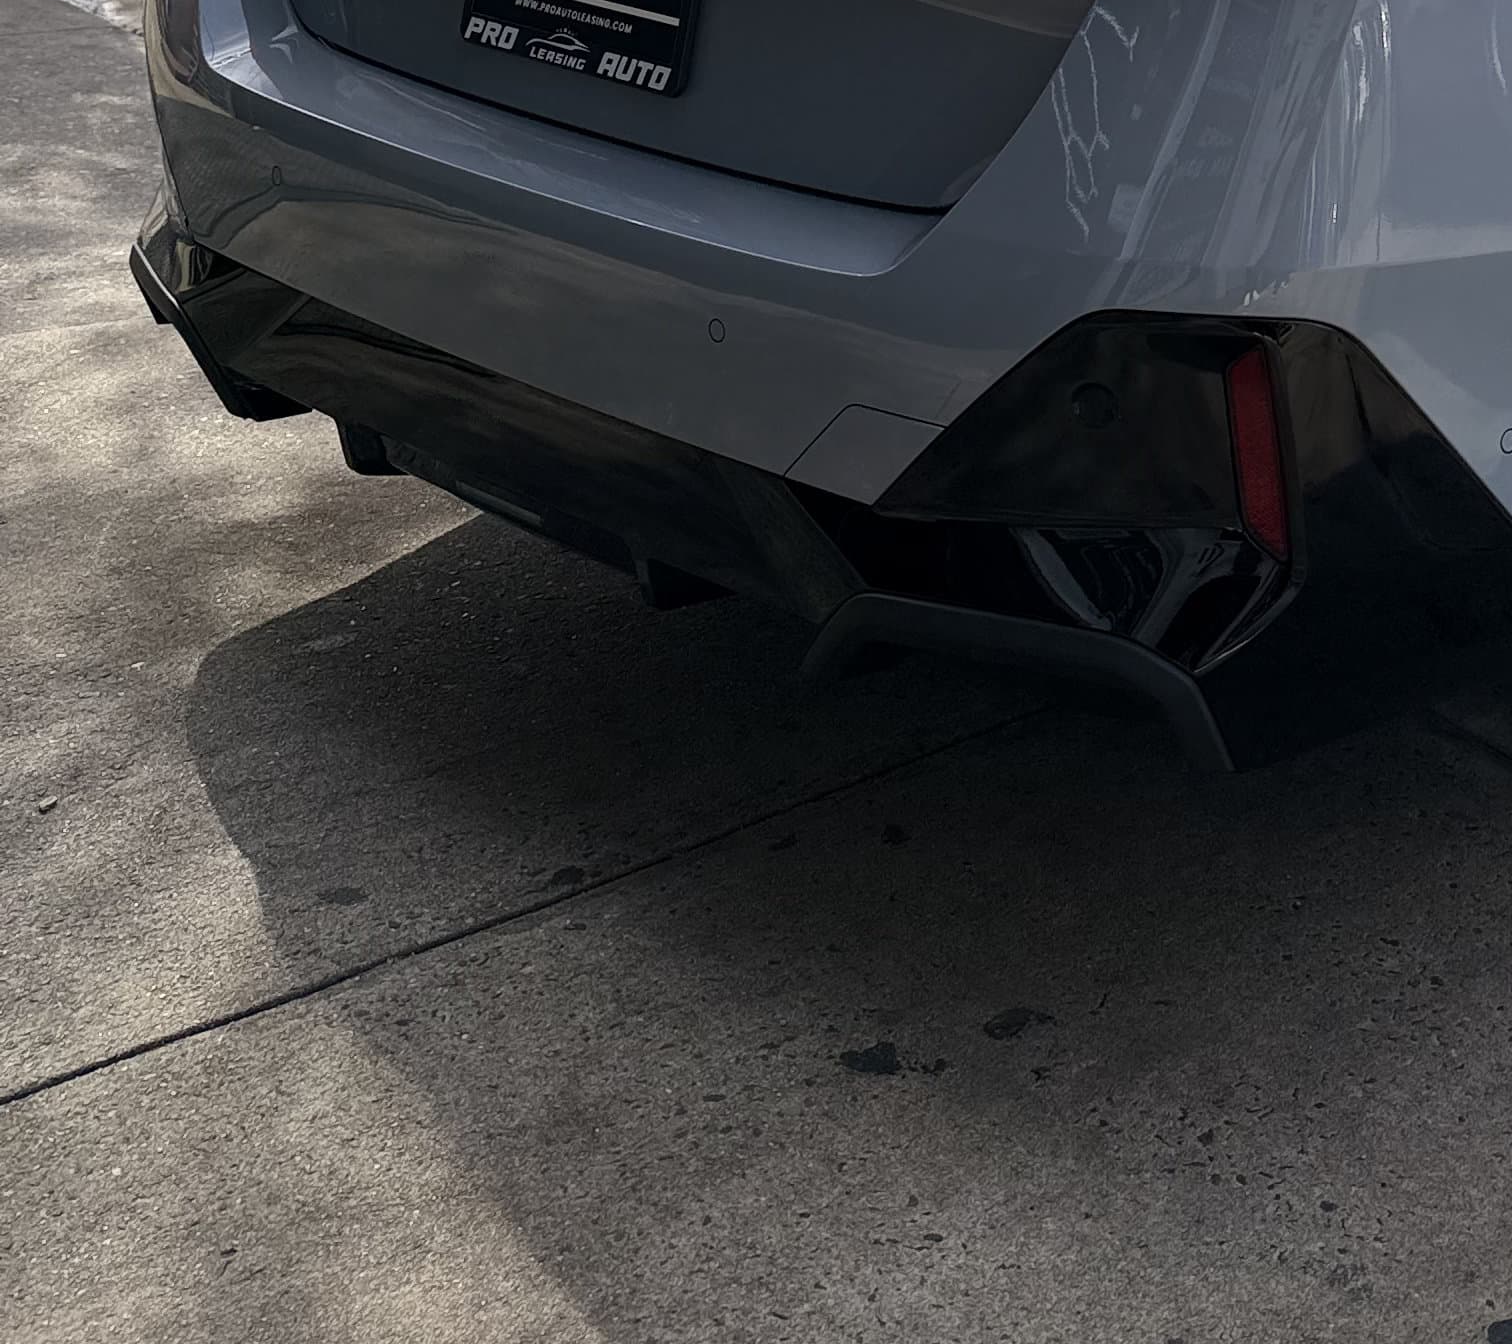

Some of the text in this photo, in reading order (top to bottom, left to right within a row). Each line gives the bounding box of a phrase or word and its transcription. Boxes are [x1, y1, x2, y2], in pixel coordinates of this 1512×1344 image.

[463, 16, 673, 92] PRO AUTO
[529, 46, 588, 71] LEASING
